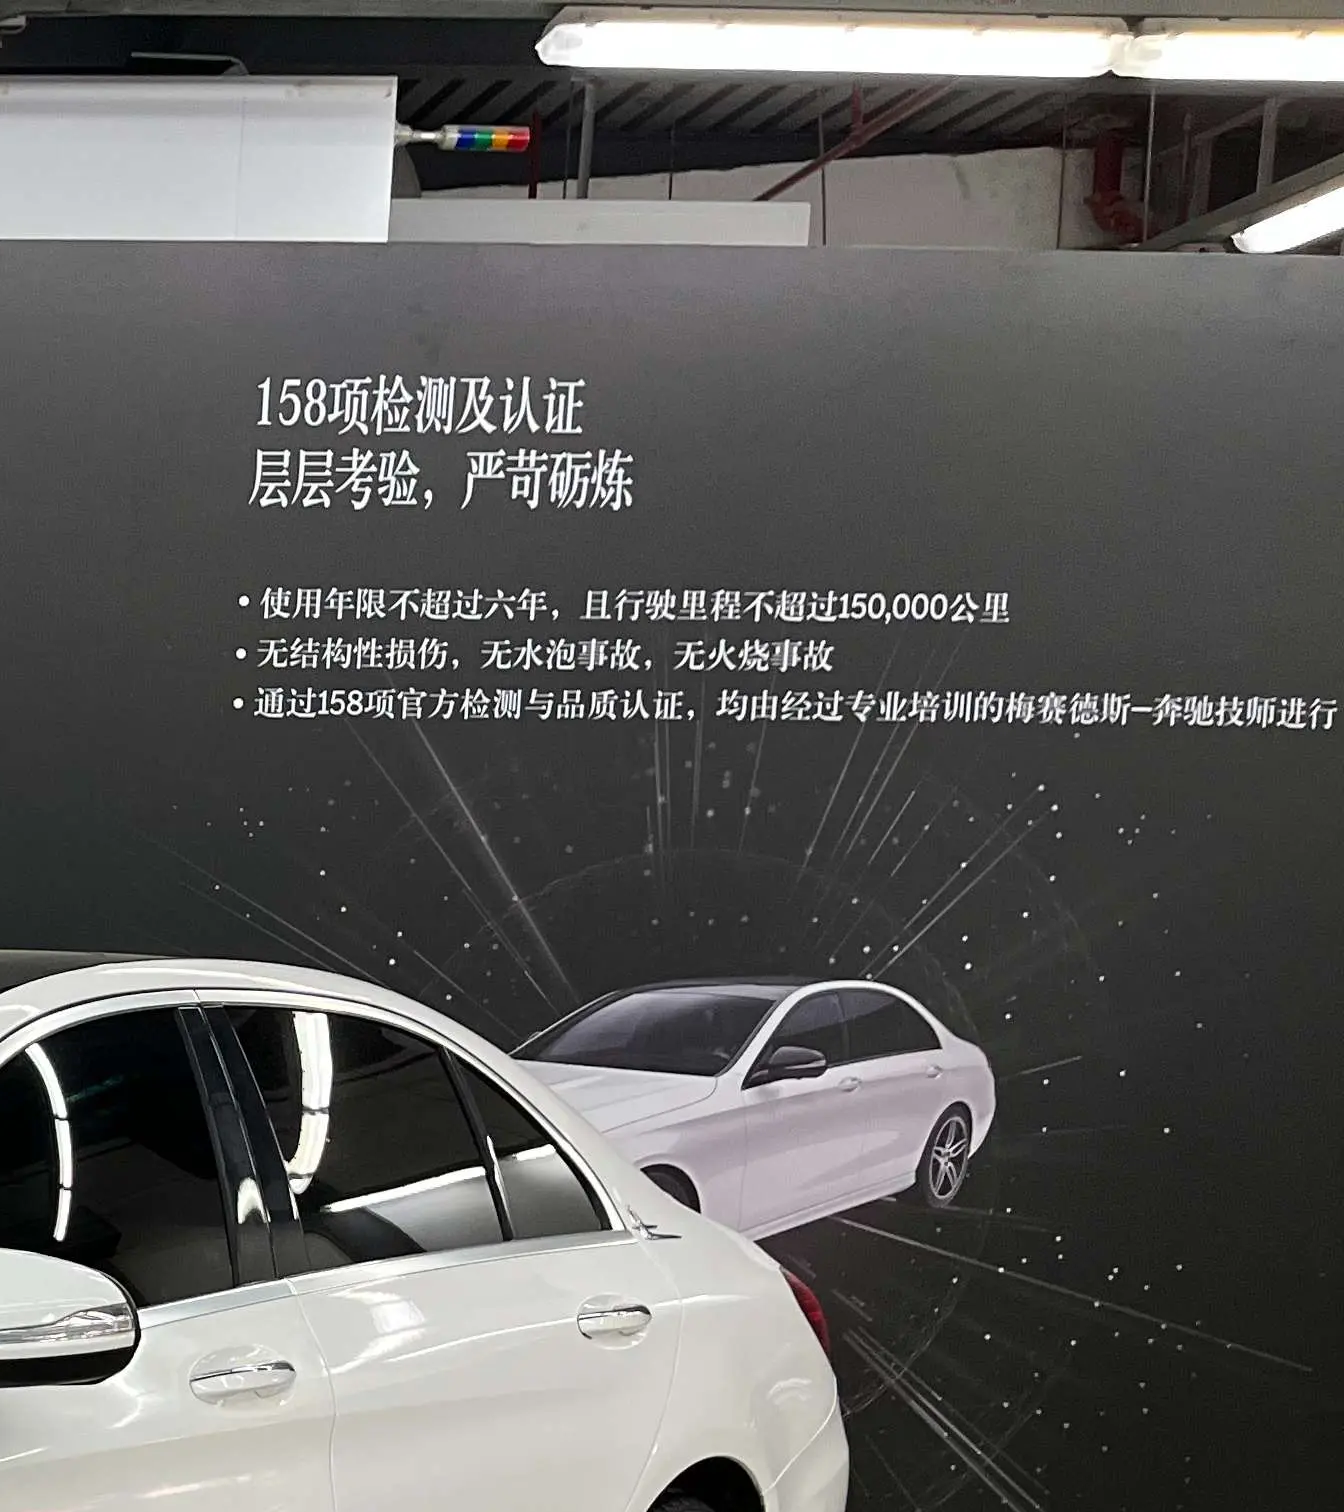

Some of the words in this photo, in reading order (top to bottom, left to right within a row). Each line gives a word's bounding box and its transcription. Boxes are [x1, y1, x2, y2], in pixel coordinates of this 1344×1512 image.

[257, 374, 586, 436] 158项检测及认证
[257, 637, 835, 673] 无结构性损伤，无水泡事故，无火烧事故
